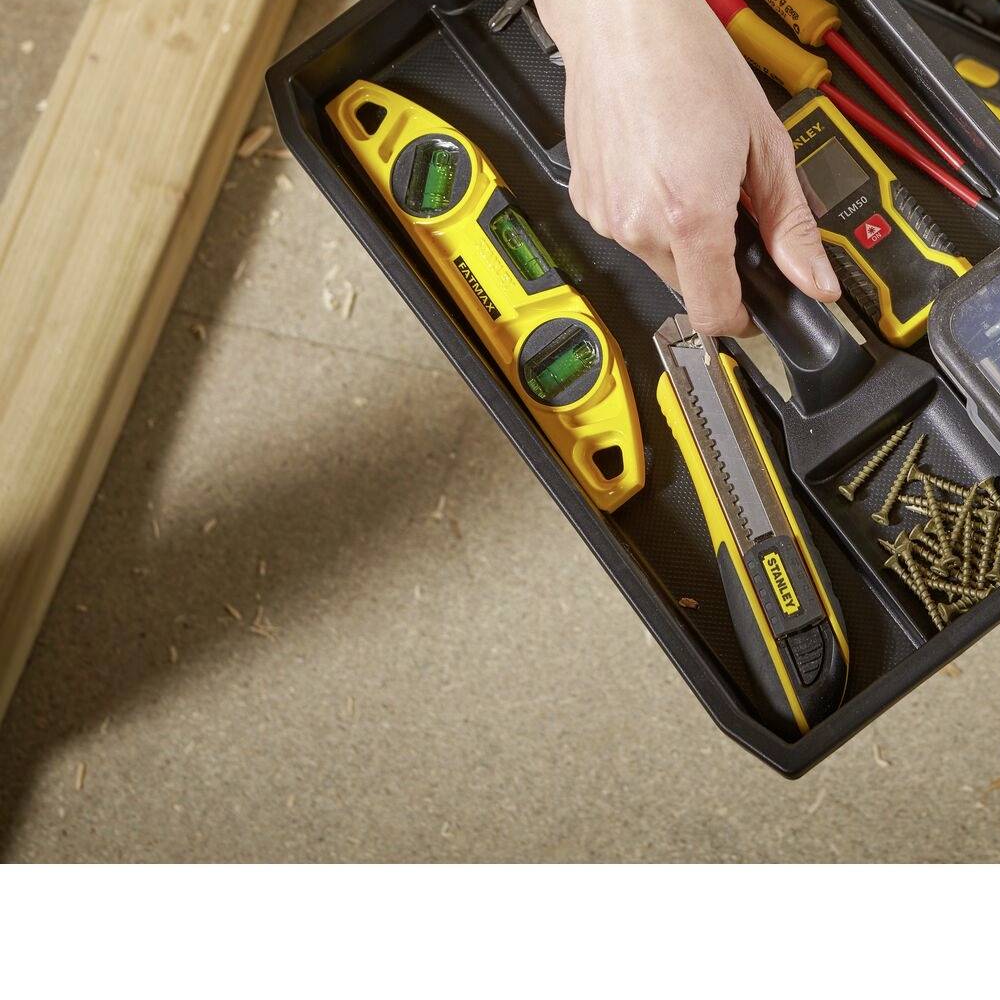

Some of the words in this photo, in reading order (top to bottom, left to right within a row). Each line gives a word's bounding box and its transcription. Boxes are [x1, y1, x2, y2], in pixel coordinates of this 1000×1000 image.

[794, 121, 824, 152] NLEY
[838, 195, 868, 221] TLM50
[871, 232, 882, 243] ON
[457, 261, 496, 314] FATMAX
[767, 558, 796, 607] STANLEY
